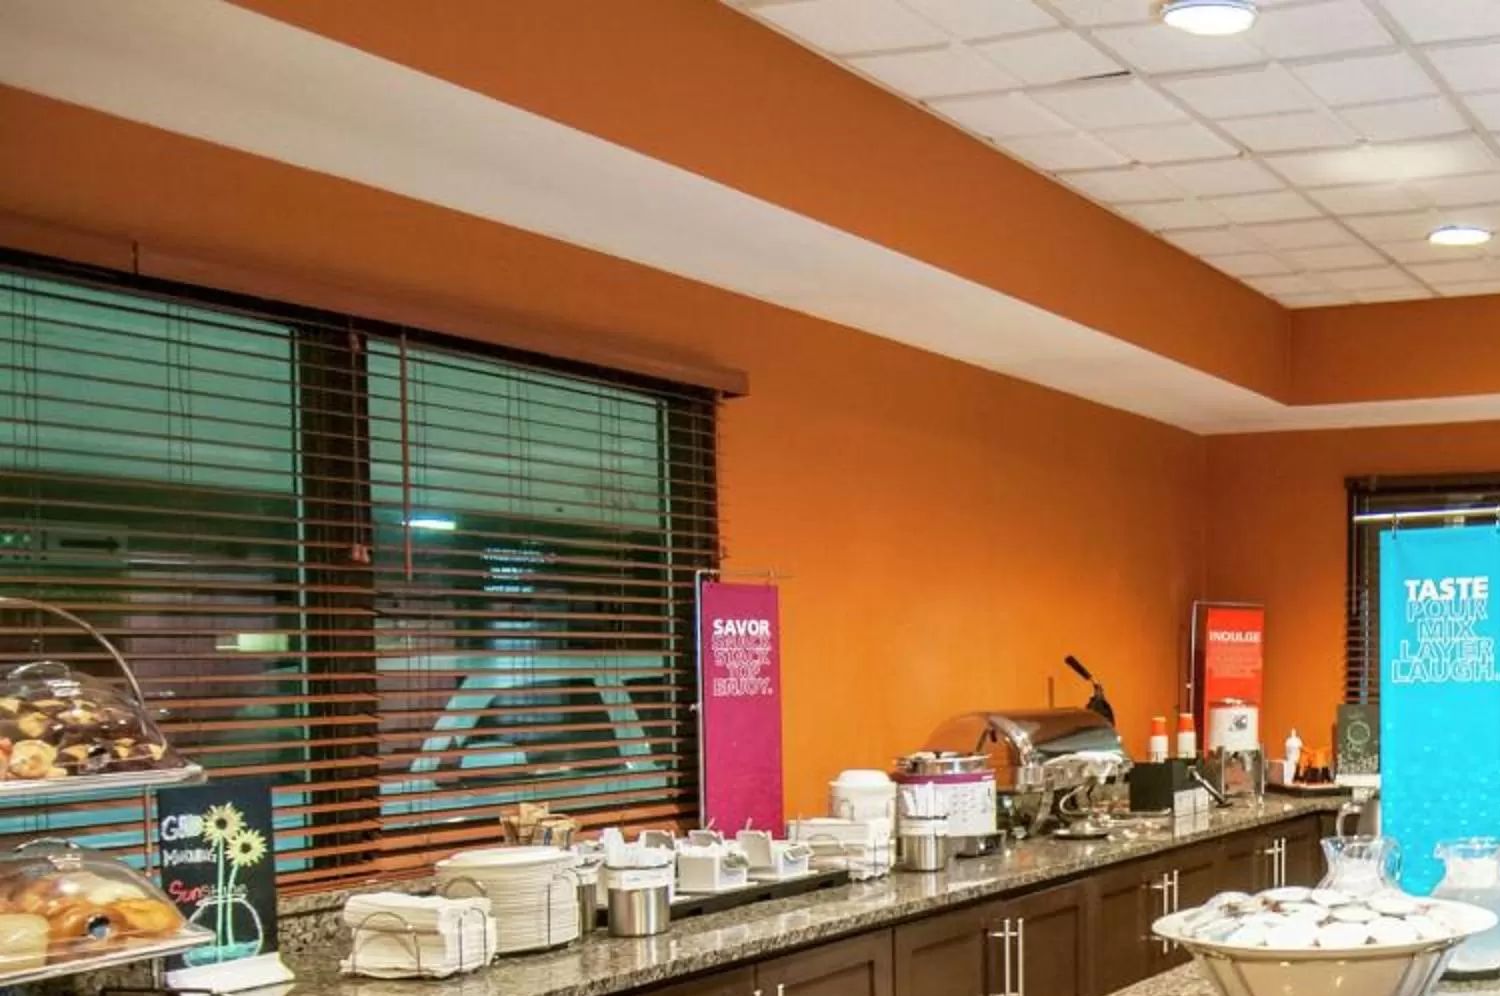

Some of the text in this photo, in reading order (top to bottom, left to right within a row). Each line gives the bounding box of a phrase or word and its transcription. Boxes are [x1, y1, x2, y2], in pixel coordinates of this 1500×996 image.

[1404, 576, 1489, 601] TASTE
[1407, 599, 1488, 622] POUR
[712, 618, 770, 636] SAVOR
[1417, 618, 1477, 642] MIX
[1400, 637, 1495, 662] LAYER
